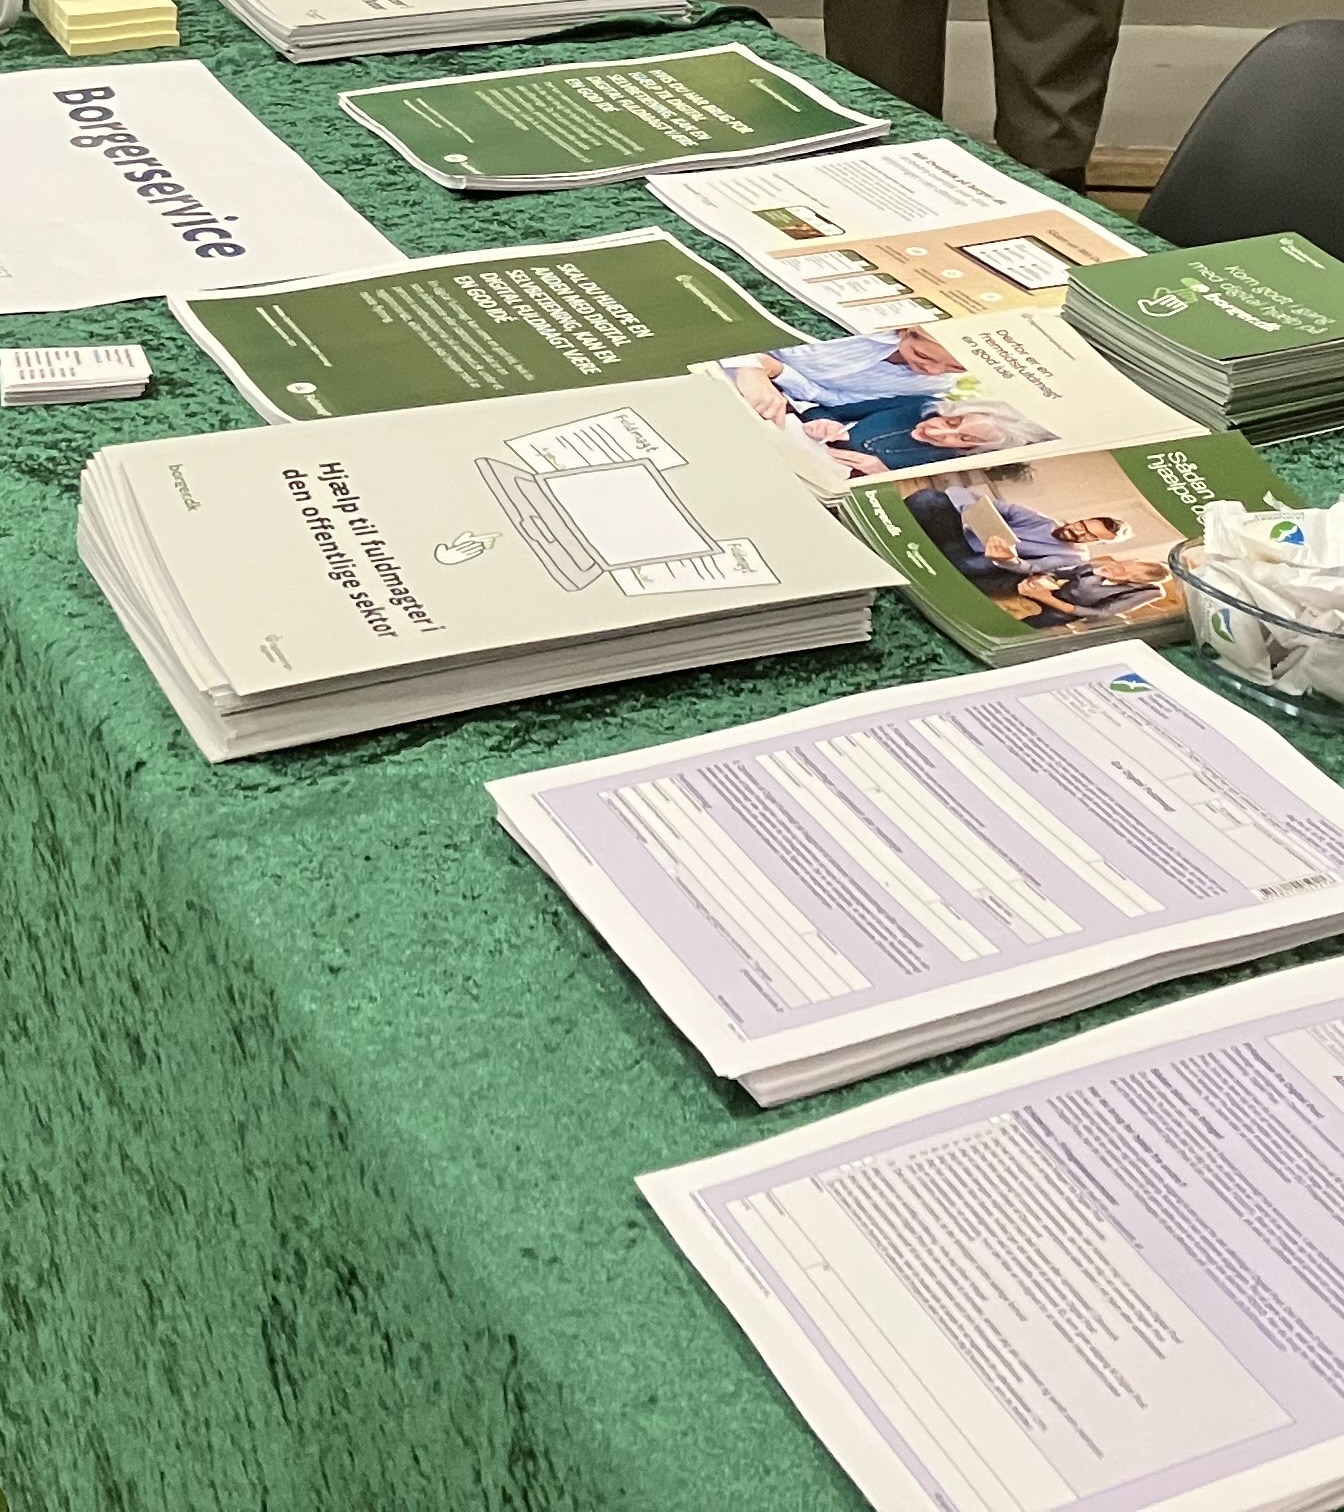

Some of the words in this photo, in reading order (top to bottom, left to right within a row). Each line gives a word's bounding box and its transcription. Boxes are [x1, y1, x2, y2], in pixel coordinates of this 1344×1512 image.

[563, 77, 587, 89] EN
[576, 87, 605, 103] GOD
[584, 75, 626, 101] DIGITAL
[672, 82, 694, 95] DU
[729, 120, 755, 135] FOR
[672, 98, 707, 123] DIGITAL
[688, 130, 713, 141] EN
[51, 85, 247, 259] Borgerservice
[555, 262, 590, 284] SKAL
[577, 281, 606, 296] DU
[1187, 261, 1229, 283] med
[1223, 265, 1261, 287] Kom
[1250, 286, 1294, 306] godt
[452, 275, 480, 289] EN
[466, 288, 498, 309] GOD
[484, 307, 521, 324] IDÉ
[479, 272, 524, 306] DIGITAL
[517, 304, 576, 351] FULDMAGT
[562, 348, 603, 376] VÆRE
[506, 268, 582, 334] SELVBETJENING,
[570, 330, 608, 351] KAN
[592, 349, 622, 364] EN
[529, 266, 576, 296] ANDEN
[561, 294, 596, 315] MED
[582, 312, 633, 348] DIGITAL
[591, 294, 641, 326] HJÆLPE
[626, 323, 656, 339] EN
[960, 335, 979, 348] en
[970, 348, 1001, 366] god
[995, 329, 1030, 356] Derfor
[1025, 356, 1042, 366] er
[1036, 366, 1054, 378] en
[978, 332, 1064, 401] fremtidsfuldmagt
[167, 463, 202, 512] borger.dk
[316, 461, 361, 514] Hjælp
[1146, 452, 1198, 504] hjælpe
[1167, 450, 1216, 500] Sådan
[347, 517, 380, 537] til
[281, 468, 313, 502] den
[301, 506, 362, 589] offentlige
[348, 591, 399, 638] sektor
[359, 539, 435, 625] fuldmagter
[419, 625, 447, 633] i
